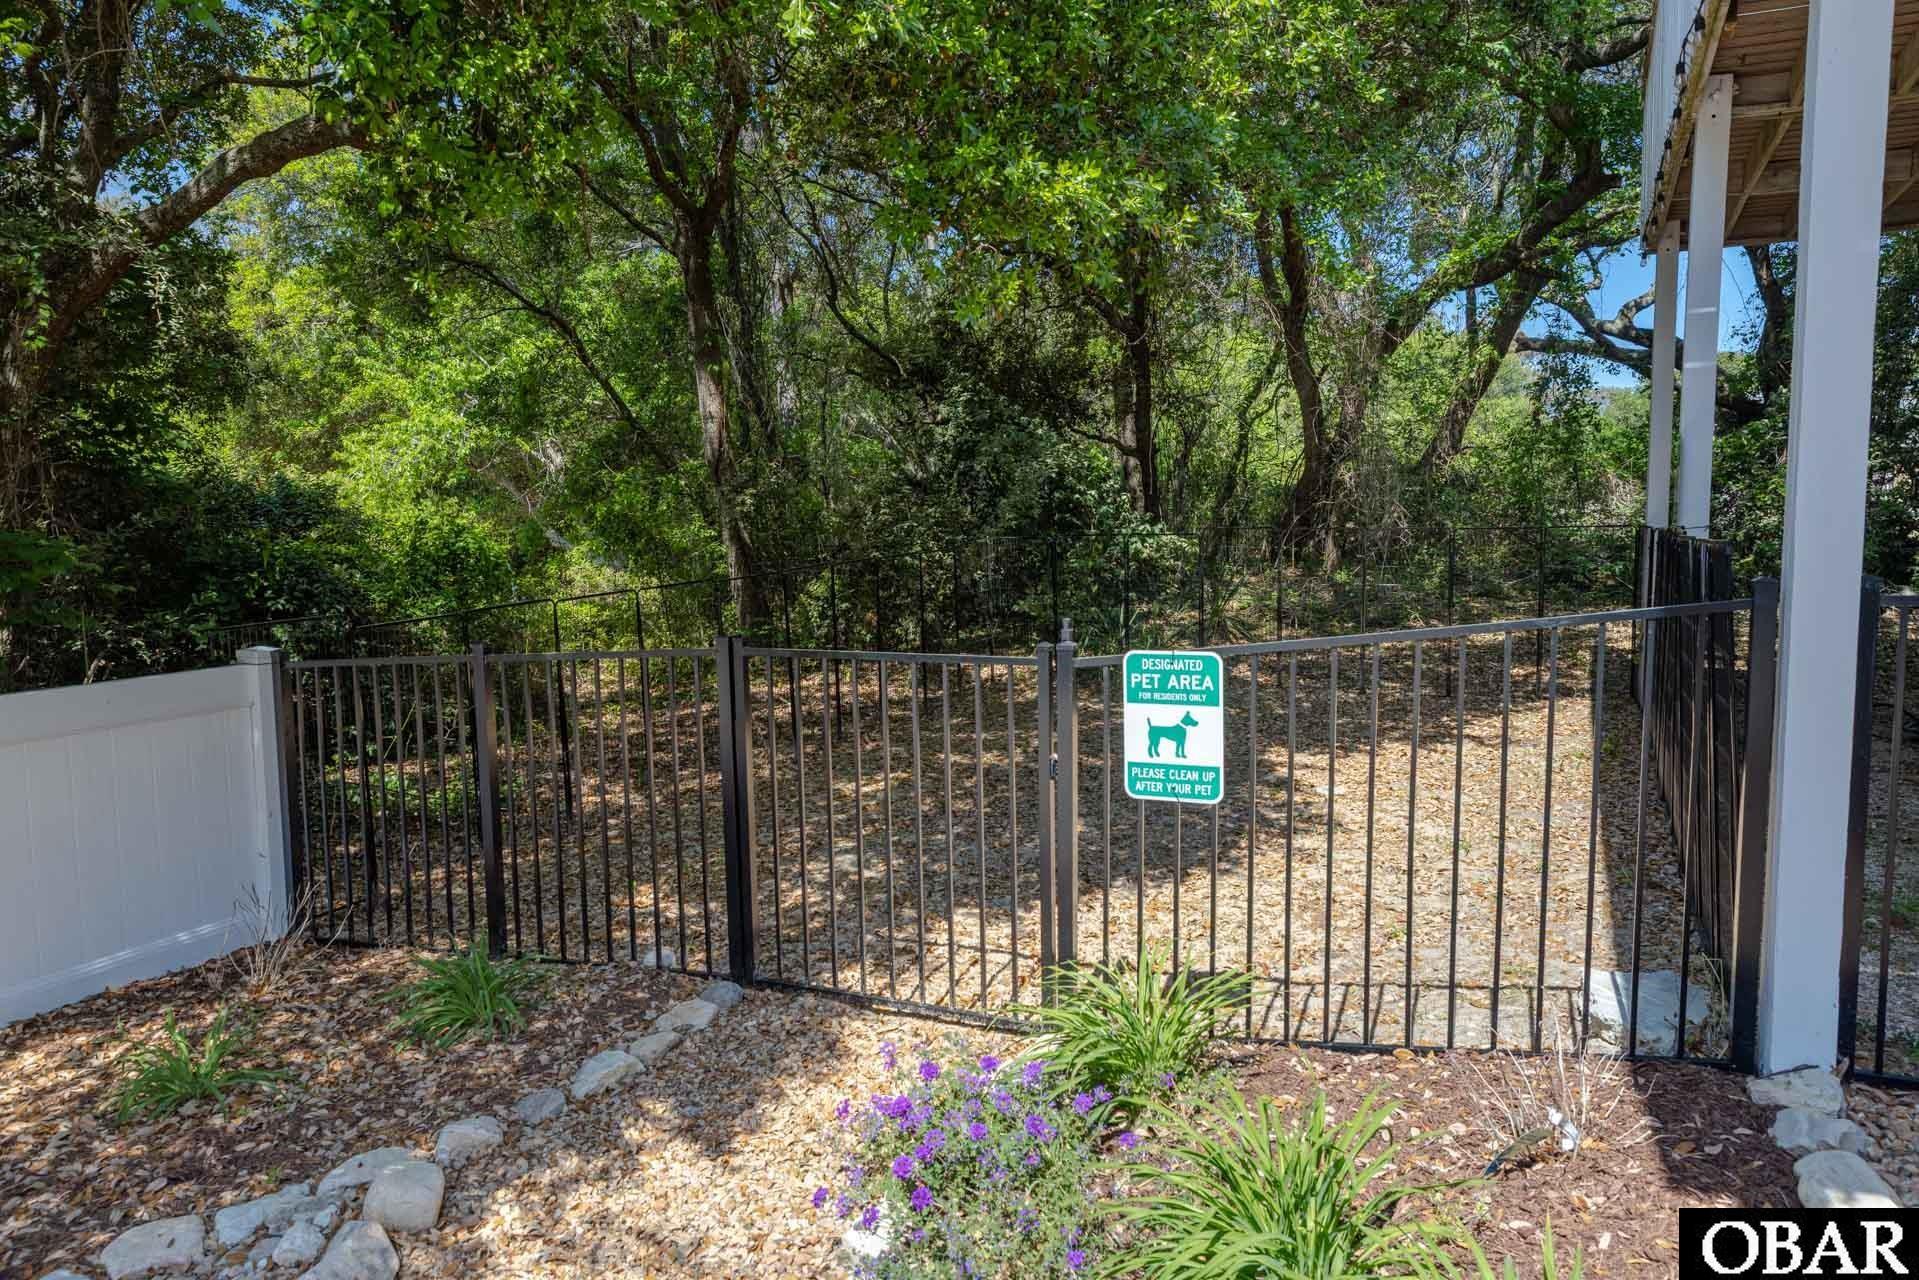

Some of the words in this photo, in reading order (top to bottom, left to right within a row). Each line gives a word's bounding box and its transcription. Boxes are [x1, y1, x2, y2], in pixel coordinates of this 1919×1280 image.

[1142, 658, 1203, 671] DESIGNATED
[1131, 673, 1160, 689] PET
[1168, 674, 1214, 691] AREA
[1138, 692, 1151, 700] FOR
[1153, 692, 1187, 701] RESIDENTS
[1189, 693, 1207, 702] ONLY
[1131, 767, 1166, 779] PLEASE
[1169, 769, 1199, 781] CLEAN
[1202, 771, 1216, 782] UP
[1135, 781, 1164, 792] AFTER
[1194, 784, 1212, 795] PET
